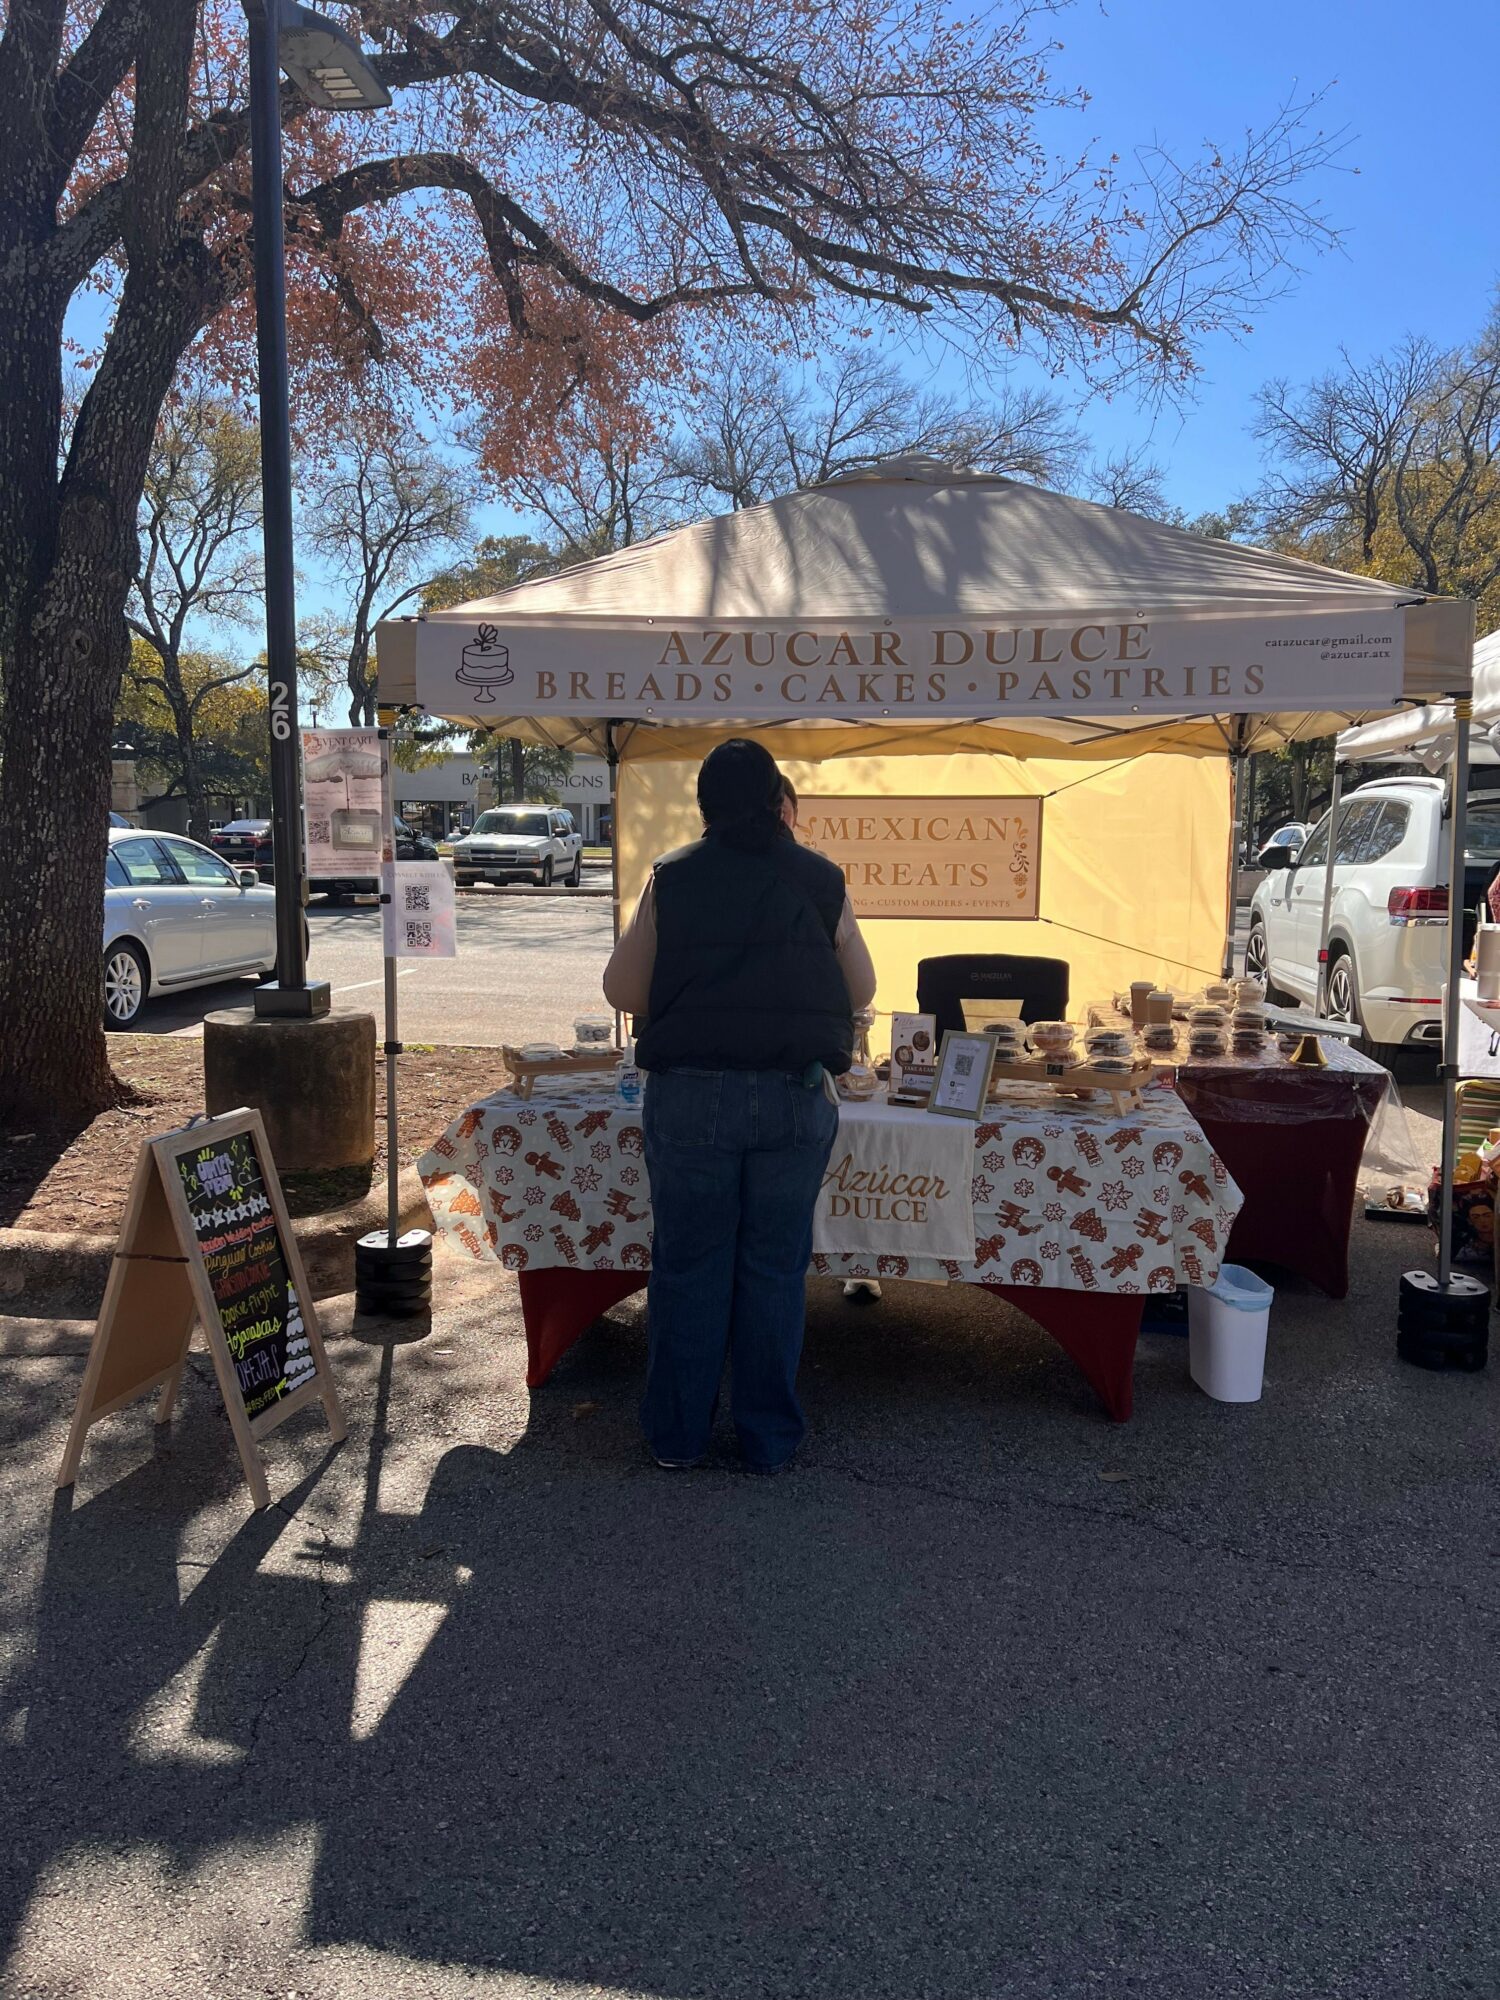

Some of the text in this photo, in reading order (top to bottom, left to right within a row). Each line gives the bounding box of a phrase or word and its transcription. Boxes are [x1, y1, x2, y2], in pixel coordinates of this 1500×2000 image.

[656, 622, 1153, 667] AZUCAR DULCE
[1320, 650, 1391, 660] @azucar.atx
[536, 664, 1265, 703] BREADS CAKES PASTRIES
[271, 681, 290, 740] 26
[315, 736, 374, 747] EVENT CART
[537, 774, 603, 788] DESIGNS
[820, 817, 1011, 841] MEXICAN
[839, 863, 989, 887] TREATS
[877, 899, 919, 907] CUSTOM
[922, 899, 962, 907] ORDERS
[972, 900, 1010, 908] EVENTS
[821, 1153, 950, 1200] Azúcar
[829, 1195, 929, 1223] DULCE
